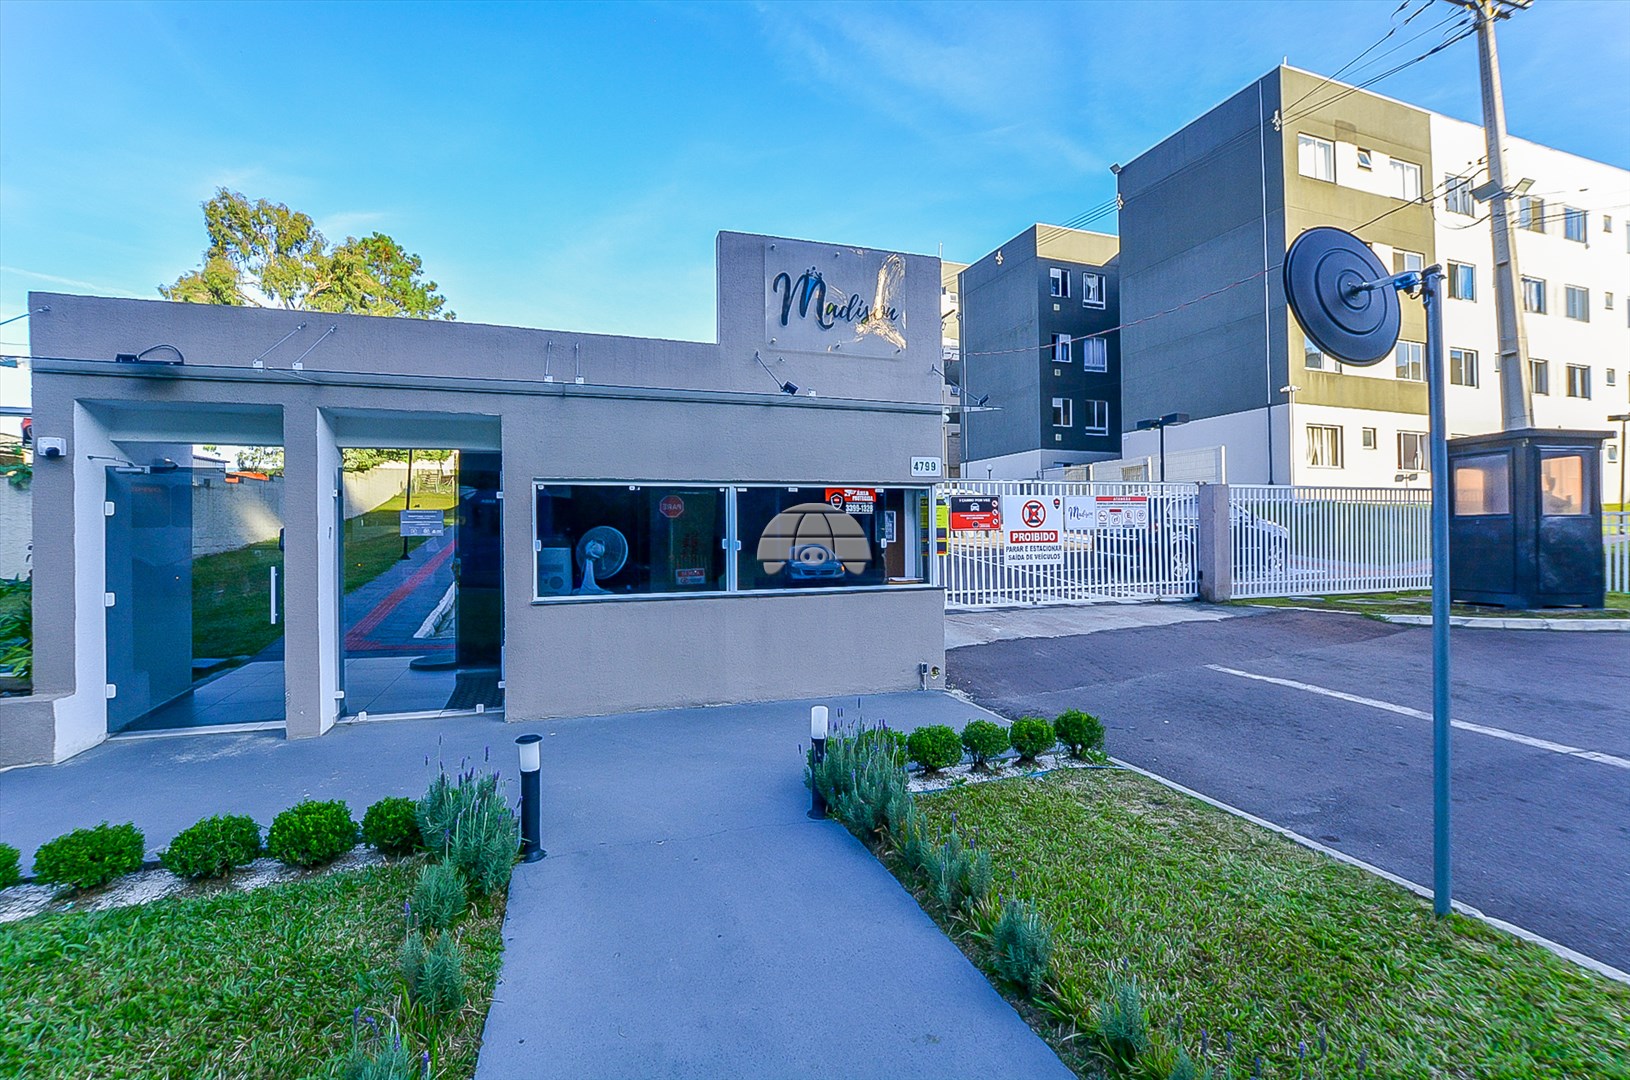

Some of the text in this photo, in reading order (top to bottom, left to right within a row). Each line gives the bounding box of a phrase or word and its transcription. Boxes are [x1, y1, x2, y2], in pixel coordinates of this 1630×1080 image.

[773, 268, 899, 330] Madison
[913, 461, 936, 471] 4799
[1012, 532, 1056, 542] PROIBIDO
